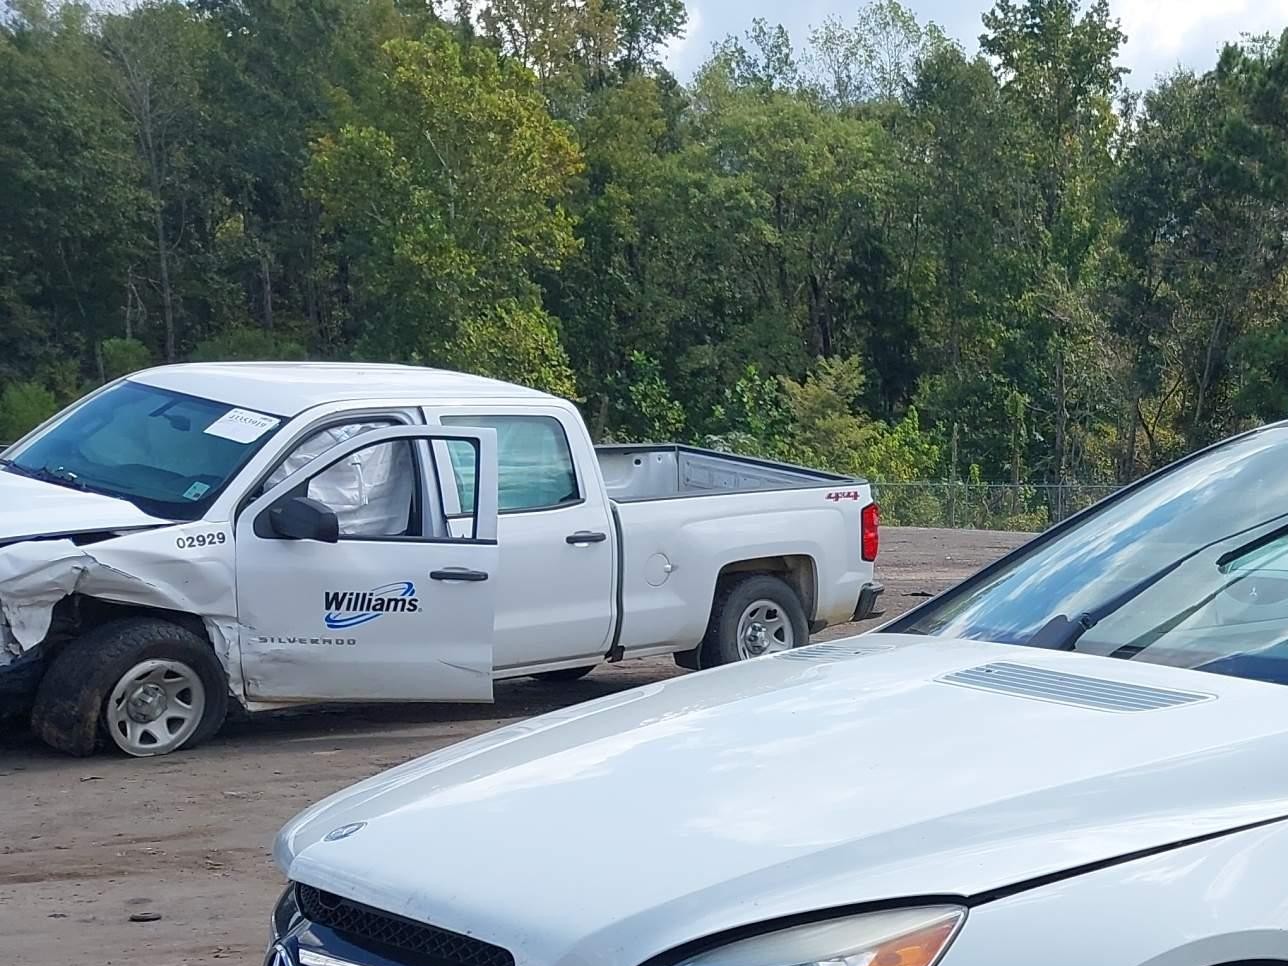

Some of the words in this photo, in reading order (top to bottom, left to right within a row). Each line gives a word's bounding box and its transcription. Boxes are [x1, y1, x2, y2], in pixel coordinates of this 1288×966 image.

[176, 531, 227, 550] 02929
[324, 590, 419, 614] Williams
[257, 635, 358, 647] SILVERADO
